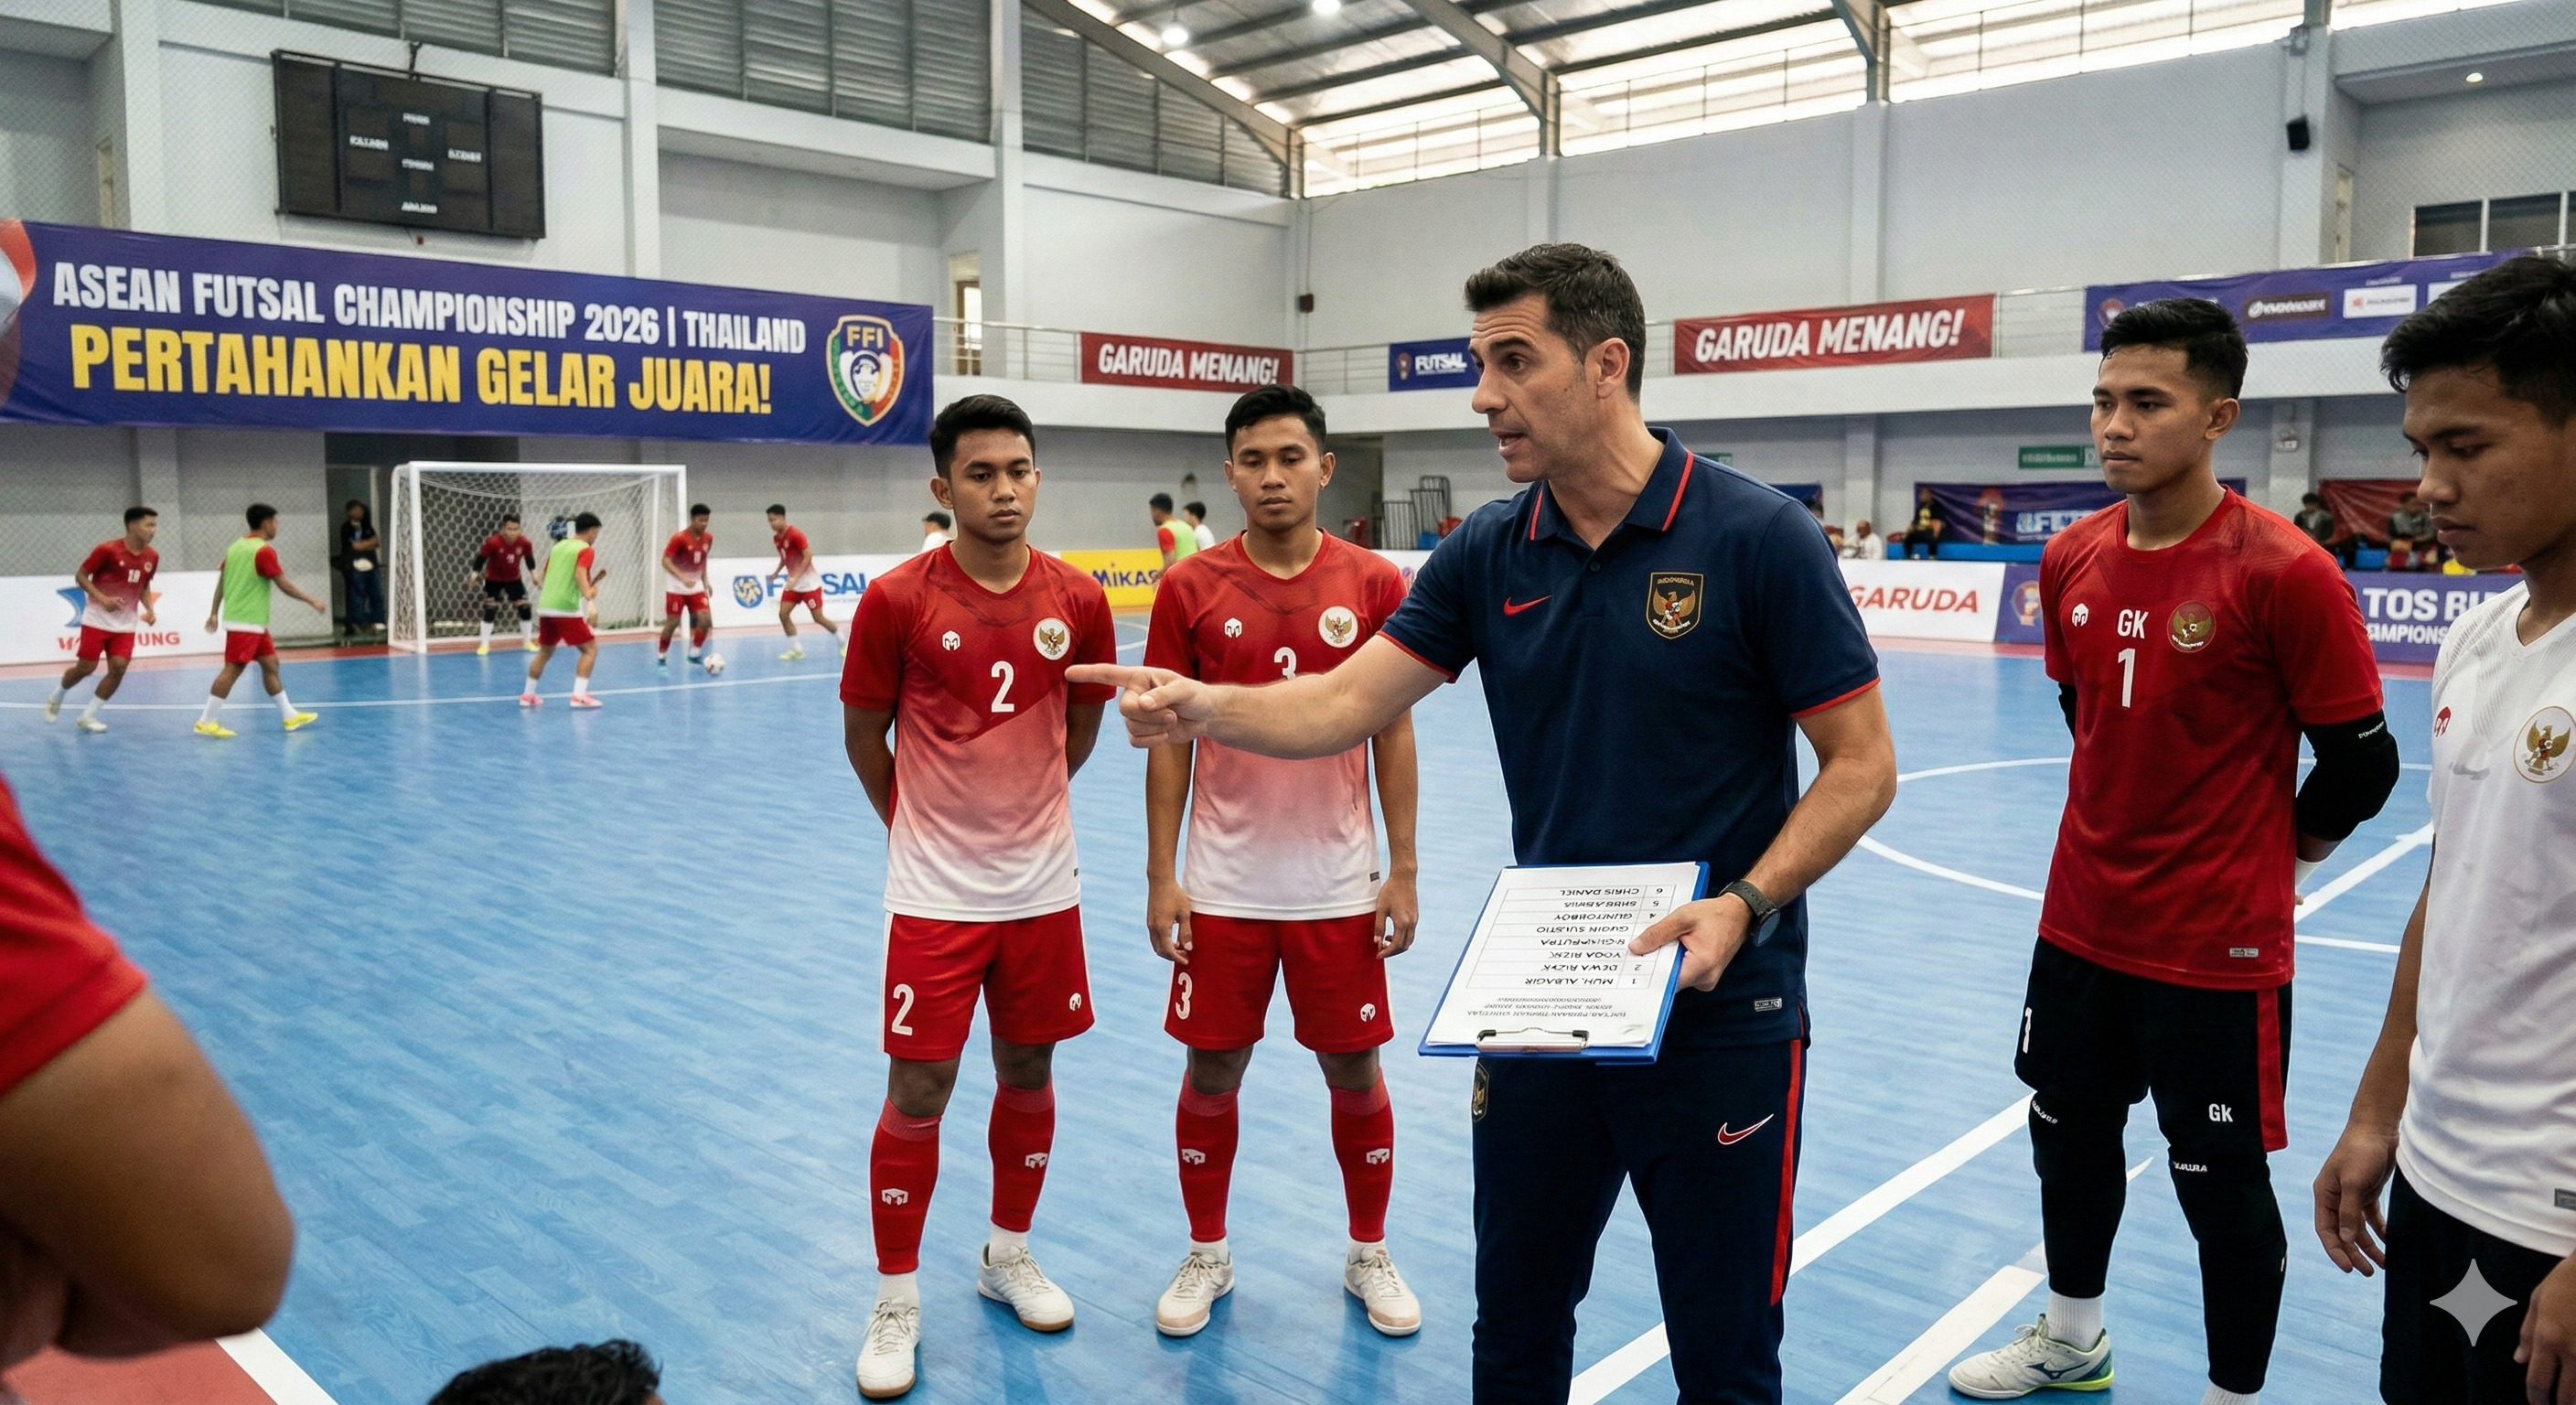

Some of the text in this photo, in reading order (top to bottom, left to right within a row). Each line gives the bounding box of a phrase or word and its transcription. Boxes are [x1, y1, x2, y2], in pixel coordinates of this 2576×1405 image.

[53, 262, 181, 314] ASEAN
[192, 272, 326, 323] FUTSAL
[334, 284, 575, 338] CHAMPIONSHIP
[584, 304, 660, 345] 2026
[682, 310, 806, 354] THAILAND
[846, 325, 884, 349] FFI
[1695, 309, 1966, 362] GARUDA MENANG!
[70, 324, 461, 402] PERTAHANKAN
[477, 347, 616, 408] GELAR
[628, 356, 771, 413] JUARA!
[1099, 342, 1280, 385] GARUDA MENANG!
[1849, 586, 1978, 613] GARUDA
[2117, 608, 2149, 638] GK
[2362, 587, 2438, 622] TOS
[991, 660, 1014, 713] 2
[1273, 647, 1297, 681] 3
[2118, 648, 2136, 708] 1
[891, 983, 915, 1036] 2
[1175, 971, 1193, 1020] 3
